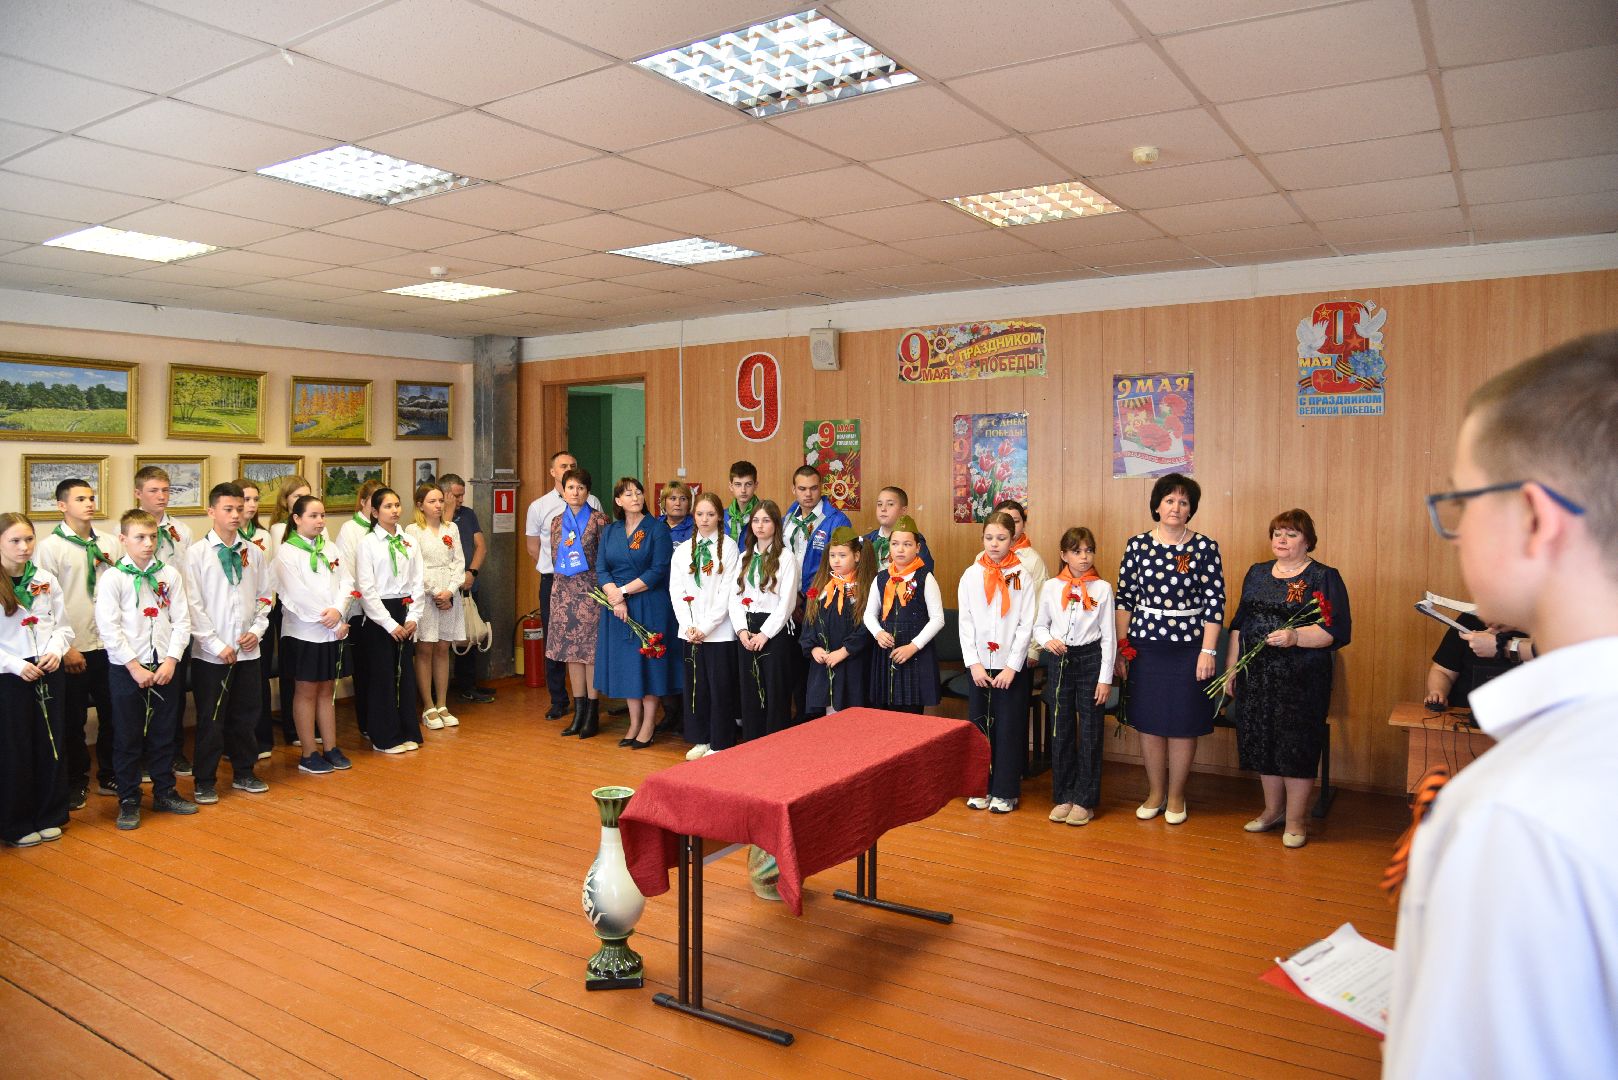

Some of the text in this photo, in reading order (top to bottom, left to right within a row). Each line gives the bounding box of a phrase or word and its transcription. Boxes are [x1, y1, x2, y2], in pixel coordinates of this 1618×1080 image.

[900, 331, 951, 382] 9 МАЯ
[946, 332, 1041, 366] С ПРАЗДНИКОМ
[1300, 301, 1371, 393] 9 МАЯ
[980, 353, 1043, 373] ПОБЕДЫ!
[736, 352, 781, 442] 9
[1118, 377, 1189, 399] 9 МАЯ
[1300, 395, 1383, 406] С ПРАЗДНИКОМ
[1299, 405, 1339, 415] ВЕЛИКОЙ
[818, 421, 855, 448] 9 МАЯ
